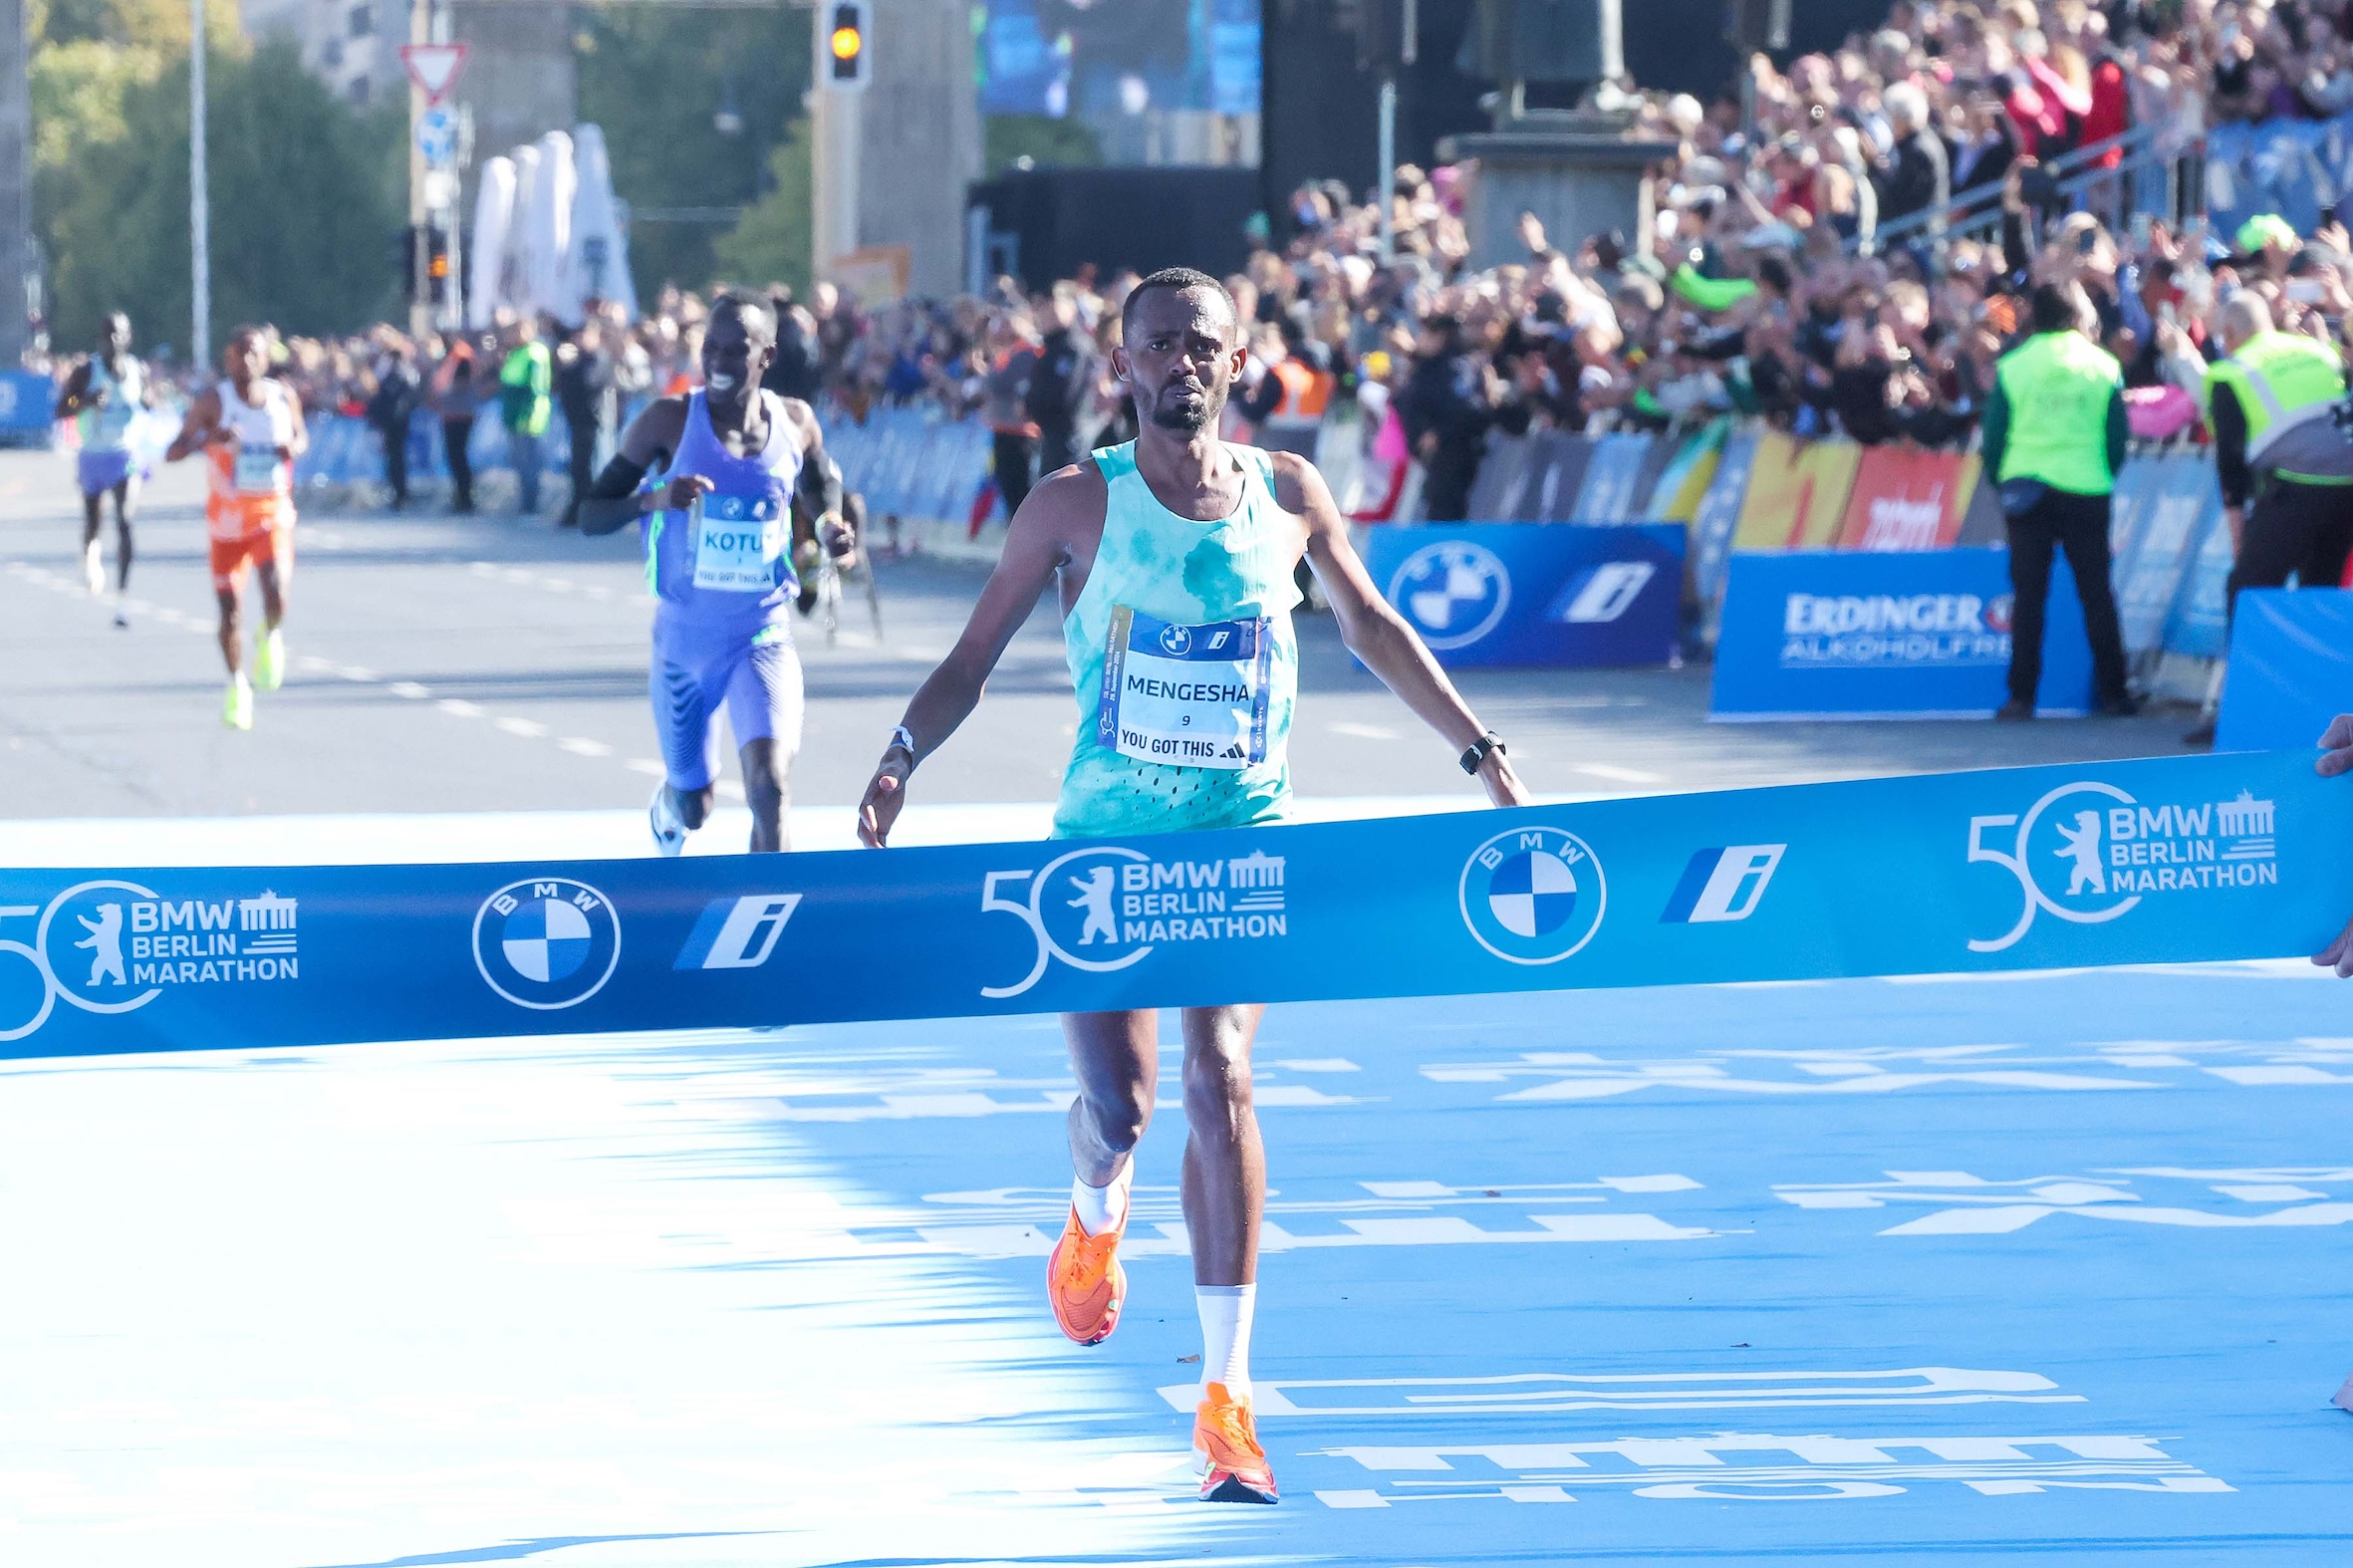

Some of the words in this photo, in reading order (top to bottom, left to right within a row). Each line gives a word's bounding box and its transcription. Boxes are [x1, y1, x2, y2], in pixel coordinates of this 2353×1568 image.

[705, 530, 775, 552] KOTU
[1786, 593, 1983, 635] ERDINGER
[1781, 635, 2013, 661] ALKOHOLFRE
[1127, 675, 1249, 702] MENGESHA
[1181, 715, 1190, 726] 9
[1122, 729, 1148, 749] YOU
[1152, 739, 1179, 755] GOT
[1182, 741, 1214, 757] THIS
[2108, 804, 2211, 841] BMW
[1478, 833, 1585, 870] BMW
[2110, 840, 2215, 866] BERLIN
[1122, 860, 1223, 892] BMW
[2112, 863, 2277, 893] MARATHON
[492, 883, 600, 916] BMW
[1123, 891, 1225, 916] BERLIN
[131, 900, 234, 932] BMW
[1124, 914, 1287, 942] MARATHON
[132, 933, 236, 958] BERLIN
[133, 957, 299, 984] MARATHON
